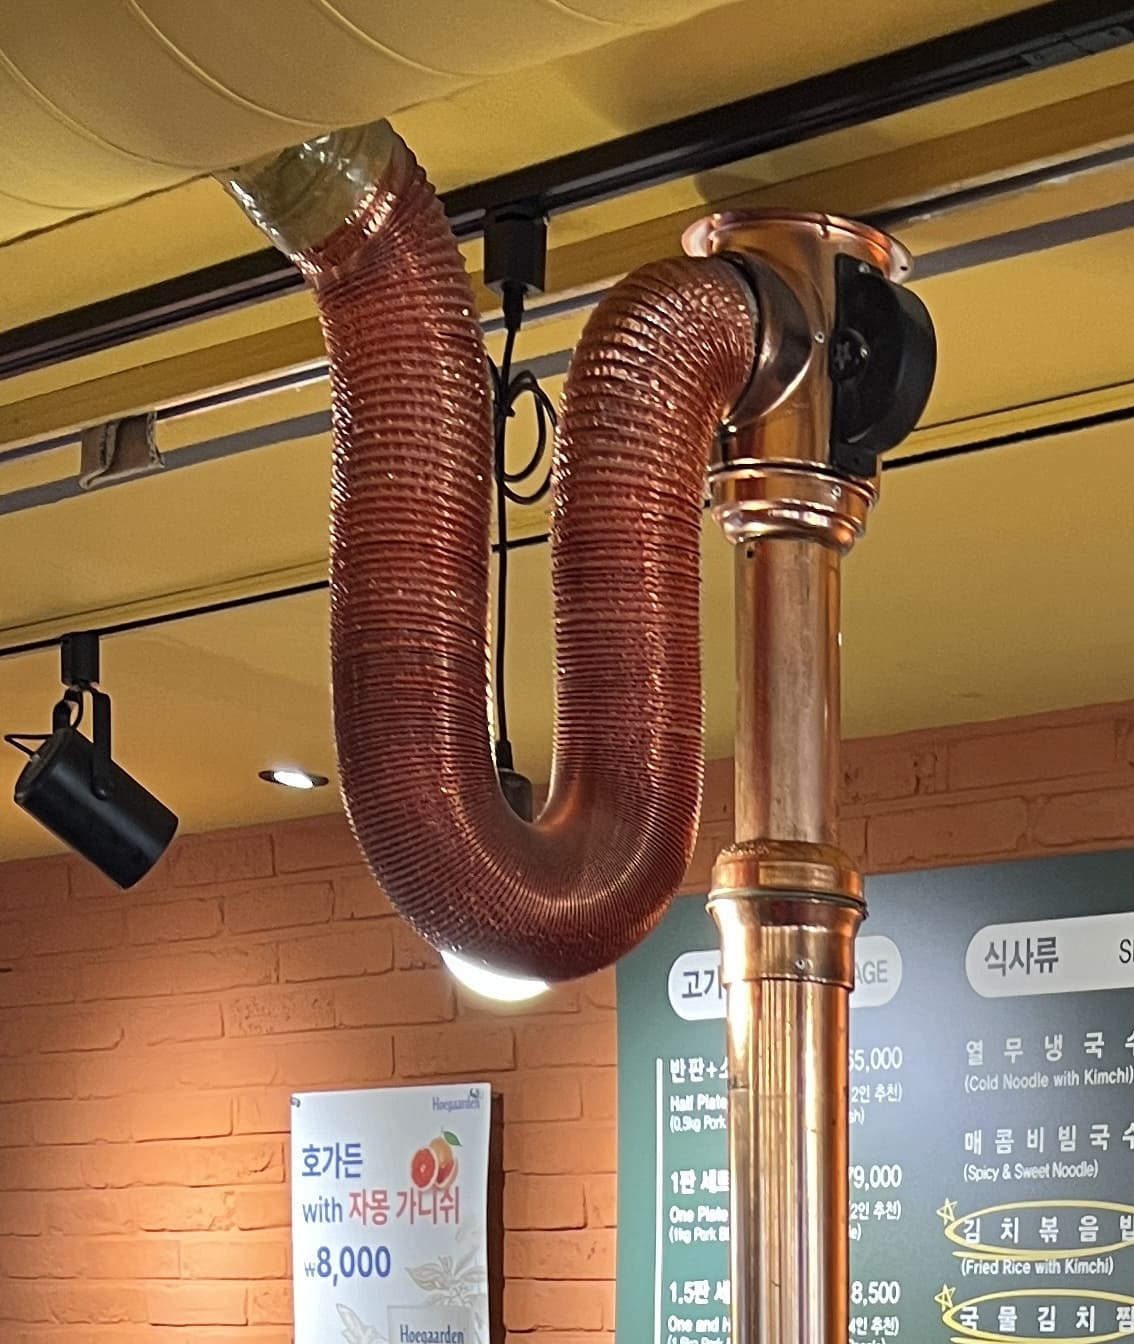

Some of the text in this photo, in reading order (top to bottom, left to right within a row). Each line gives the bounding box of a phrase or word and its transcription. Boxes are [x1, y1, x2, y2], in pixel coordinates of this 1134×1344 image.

[984, 935, 1059, 977] 식사류
[964, 1065, 1134, 1094] (Cold Noodle with Kimchi)
[703, 1115, 728, 1131] Pork
[301, 1143, 363, 1179] 호가든
[963, 1159, 1099, 1183] (Spicy & Sweet Noodle)
[849, 1163, 903, 1191] 9,000
[302, 1186, 460, 1226] with 자몽 가니쉬
[669, 1205, 695, 1224] One
[961, 1256, 1114, 1277] (Fried Rice with Kimchi)
[850, 1280, 900, 1306] 8,500
[667, 1314, 694, 1333] One
